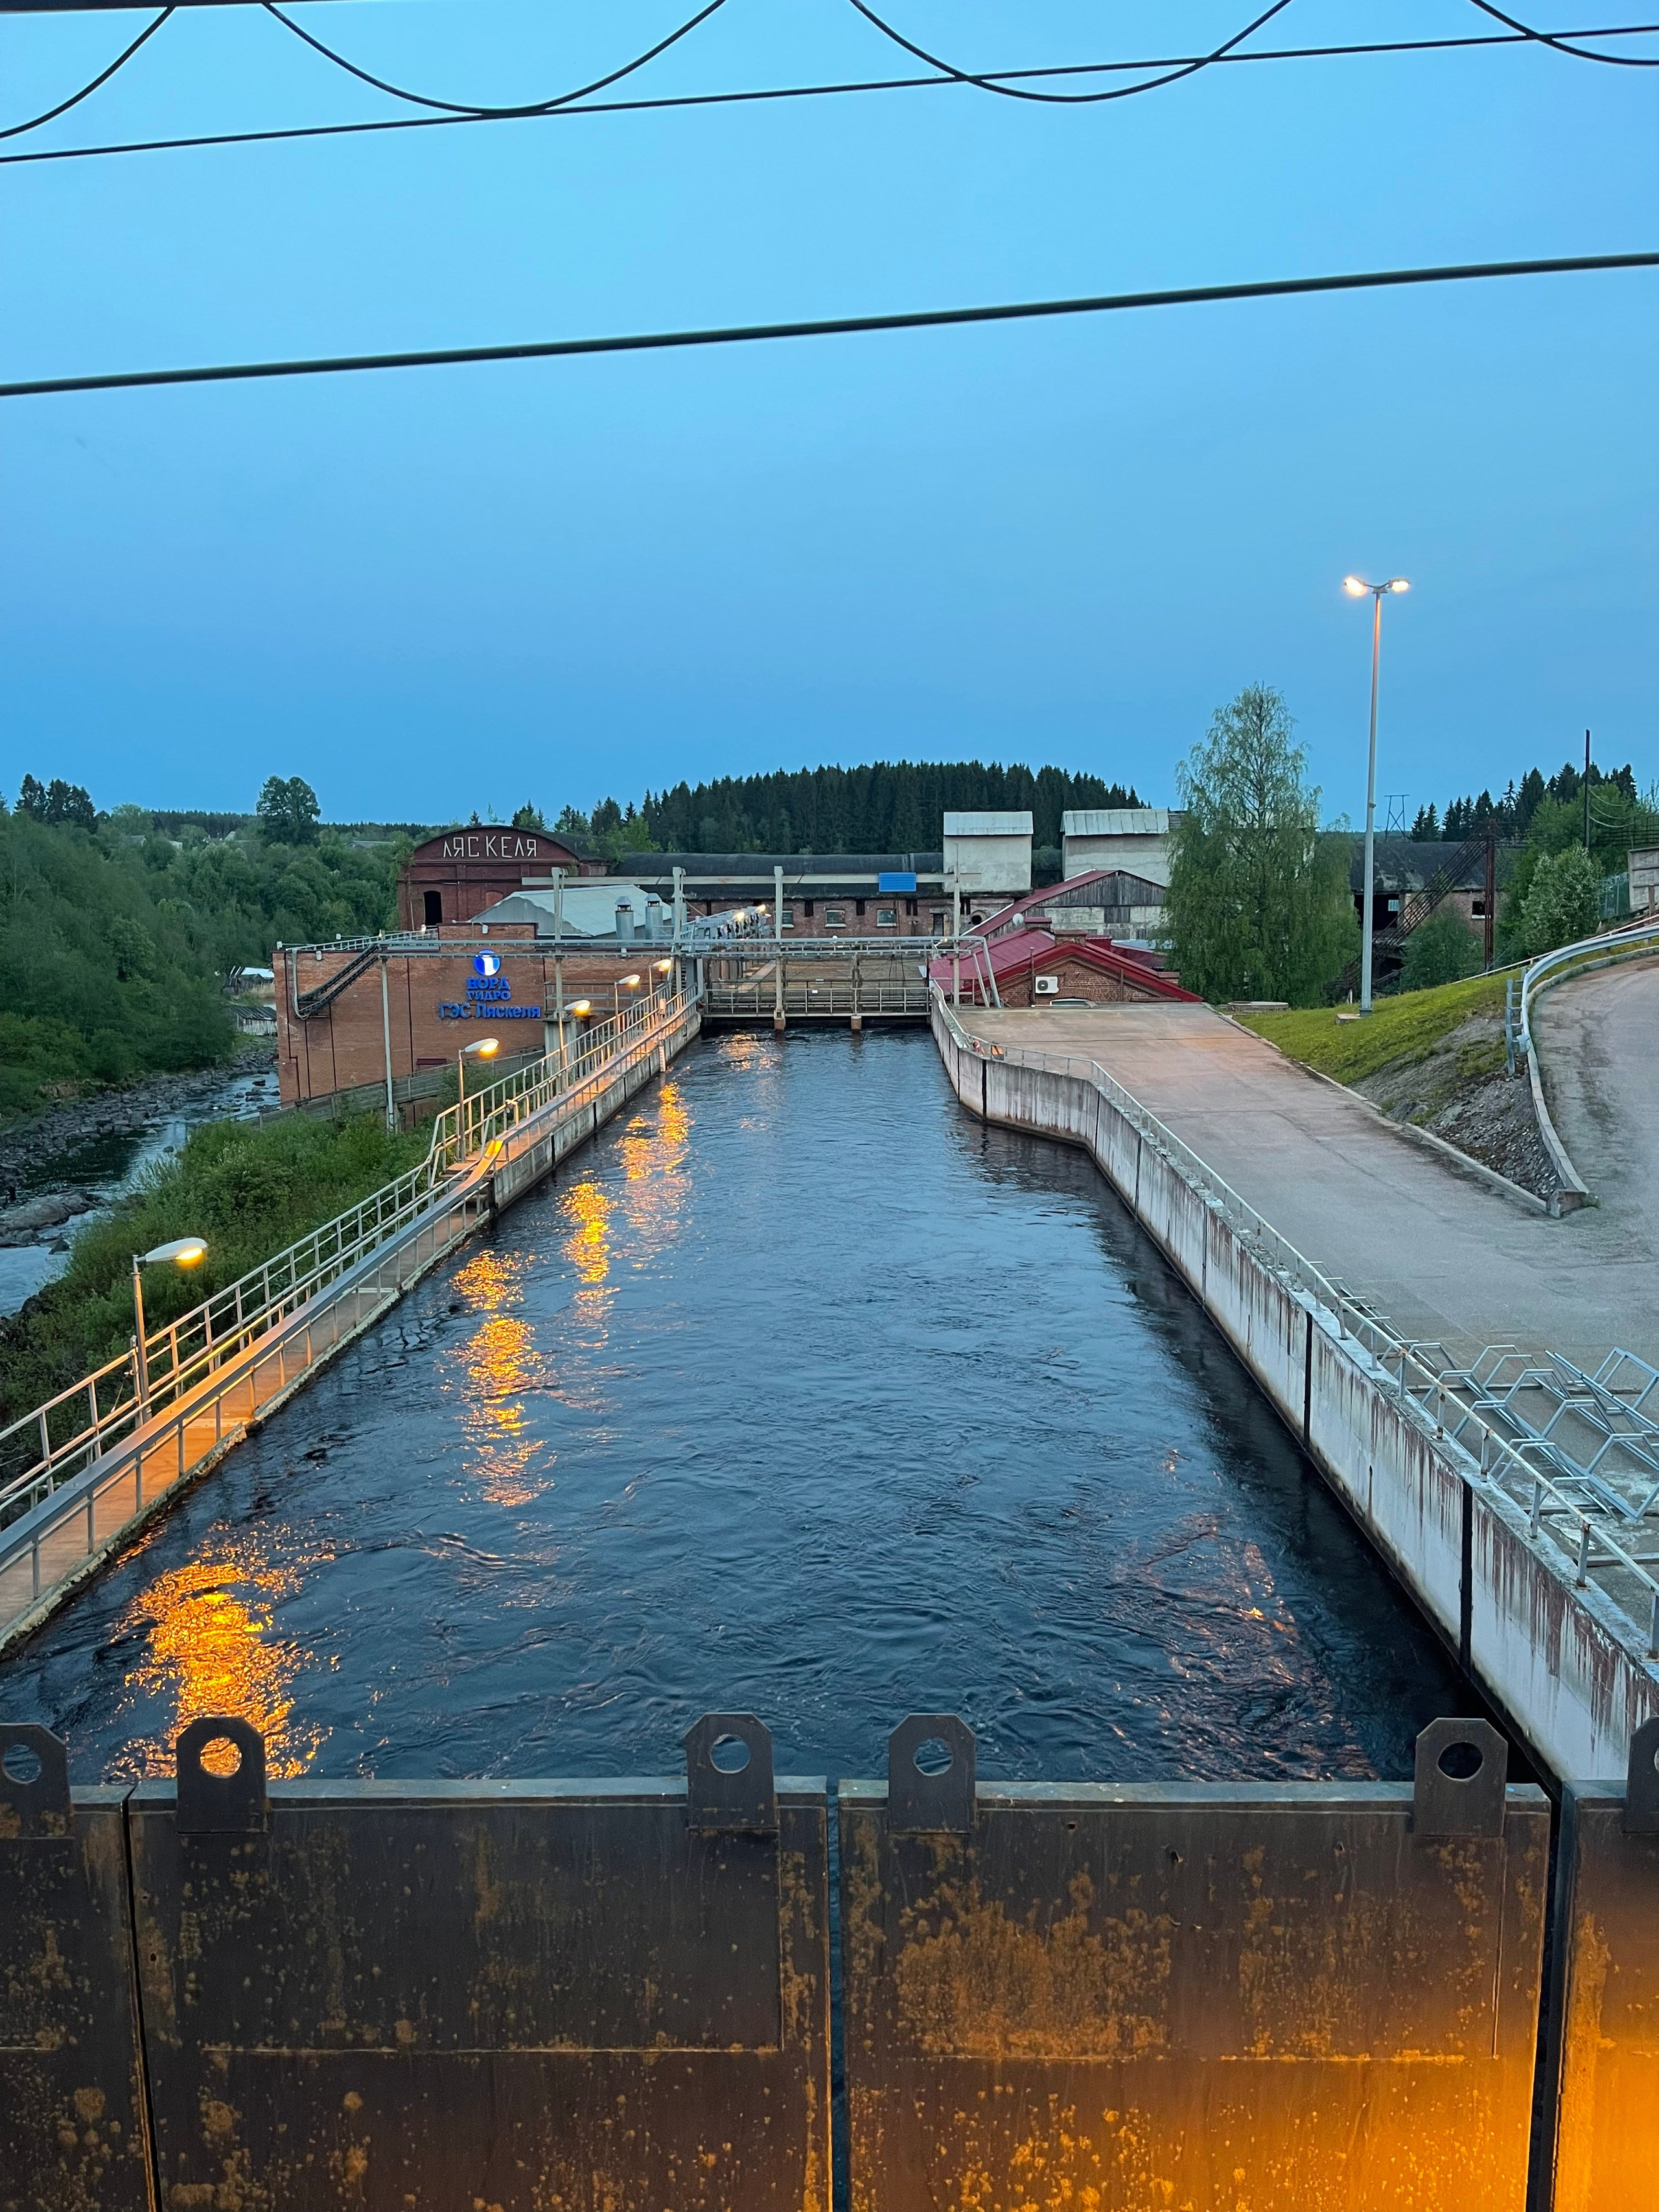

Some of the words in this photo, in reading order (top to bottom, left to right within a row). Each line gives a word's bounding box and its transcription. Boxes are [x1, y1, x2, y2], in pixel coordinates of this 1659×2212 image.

[467, 977, 511, 990] НОРД
[467, 990, 511, 1001] ГИДРО
[439, 1003, 471, 1019] ГЭС
[476, 1003, 542, 1019] Ляскеля
